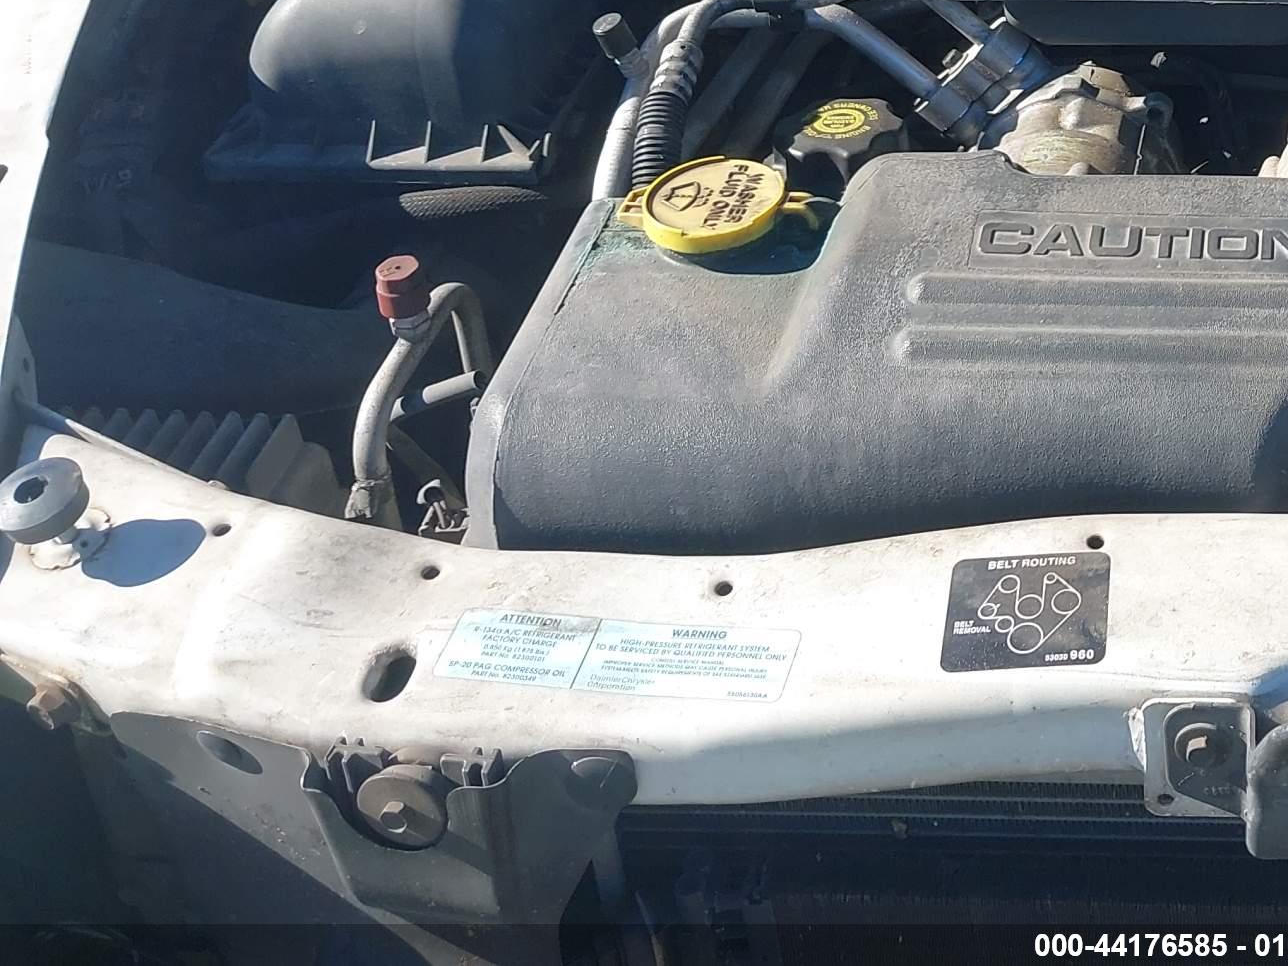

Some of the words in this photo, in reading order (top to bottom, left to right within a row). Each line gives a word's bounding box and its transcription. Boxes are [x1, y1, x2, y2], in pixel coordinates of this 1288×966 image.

[719, 164, 750, 198] FLUID
[724, 172, 765, 224] WASHER
[700, 199, 731, 231] ONLY
[987, 559, 1019, 571] BELT
[1021, 556, 1077, 569] ROUTING
[500, 613, 562, 627] ATTENTION
[954, 620, 975, 628] BELT
[473, 625, 505, 635] R-134a
[504, 627, 521, 636] A/C
[522, 629, 576, 642] REFRIGERANT
[672, 628, 728, 640] WARNING
[953, 625, 992, 635] REMOVAL
[481, 634, 520, 644] FACTORY
[522, 638, 557, 649] CHARGE
[619, 637, 682, 650] HIGH-PRESSURE
[684, 641, 739, 652] REFRIGERANT
[740, 644, 771, 652] SYSTEM
[481, 650, 499, 658] PART
[594, 643, 607, 651] TO
[607, 644, 618, 652] BE
[619, 645, 660, 656] SERVICED
[661, 647, 672, 656] BY
[672, 649, 716, 659] QUALIFIED
[717, 651, 764, 660] PERSONNEL
[765, 654, 788, 662] ONLY
[1069, 649, 1095, 661] 960
[448, 660, 473, 669] SP-20
[473, 661, 492, 671] PAG
[494, 664, 551, 676] COMPRESSOR
[552, 668, 566, 677] OIL
